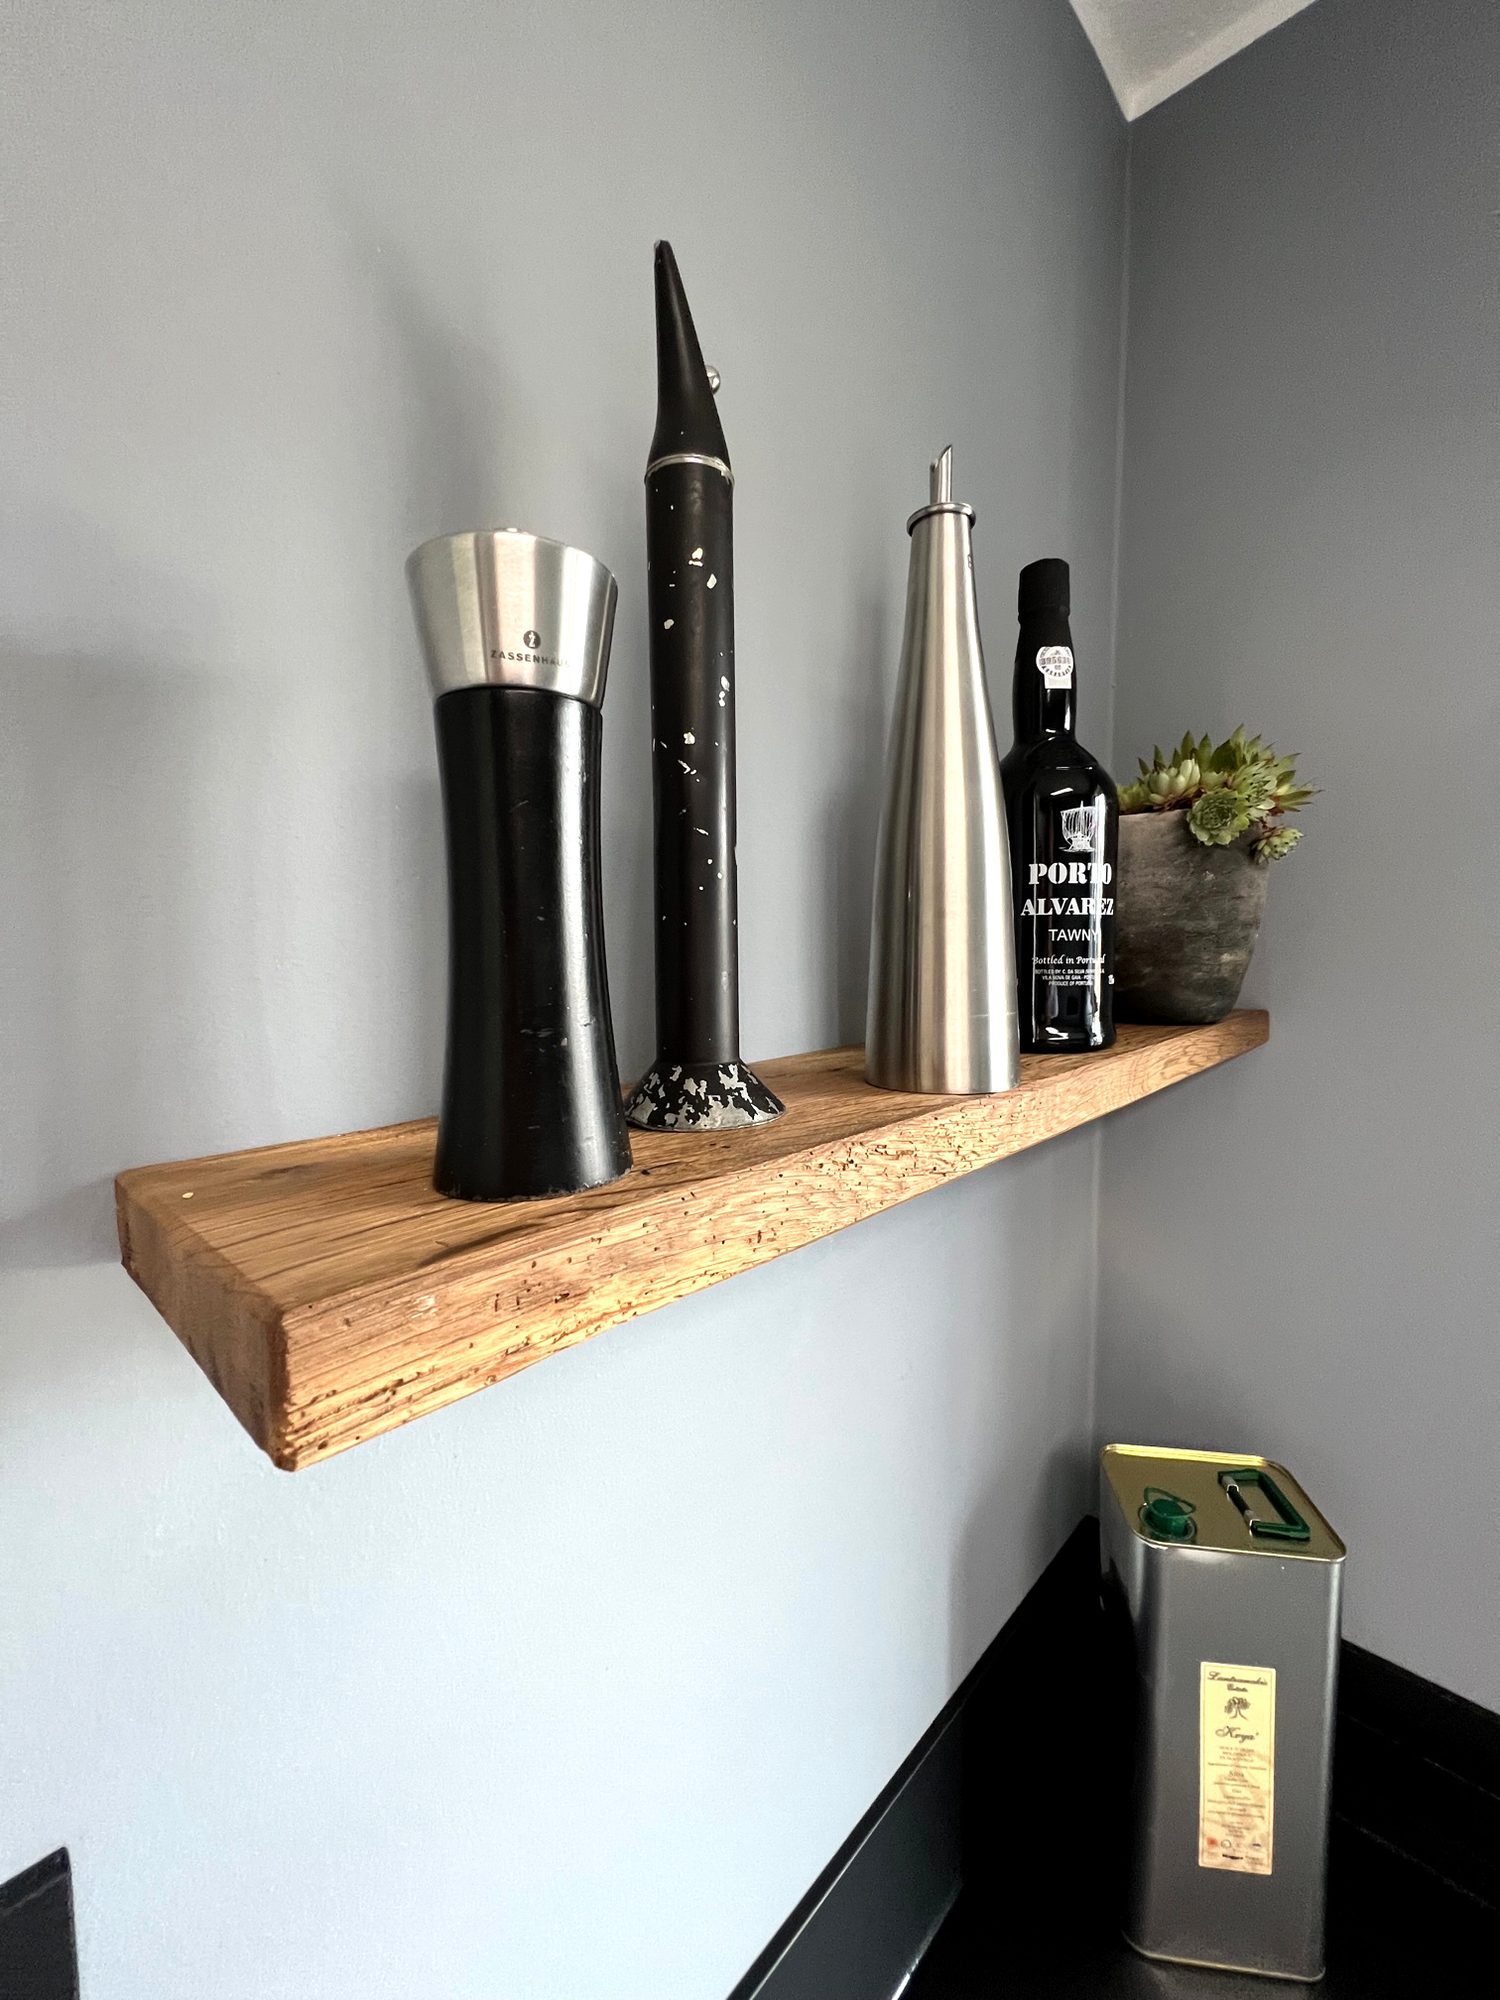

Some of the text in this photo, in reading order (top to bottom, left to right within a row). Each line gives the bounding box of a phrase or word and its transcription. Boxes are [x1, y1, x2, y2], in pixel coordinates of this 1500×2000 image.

[1028, 862, 1112, 885] PORTO
[1020, 897, 1114, 916] ALVAREZ
[1048, 928, 1098, 942] TAWNY
[1032, 953, 1065, 965] Bottled
[1066, 956, 1074, 965] in
